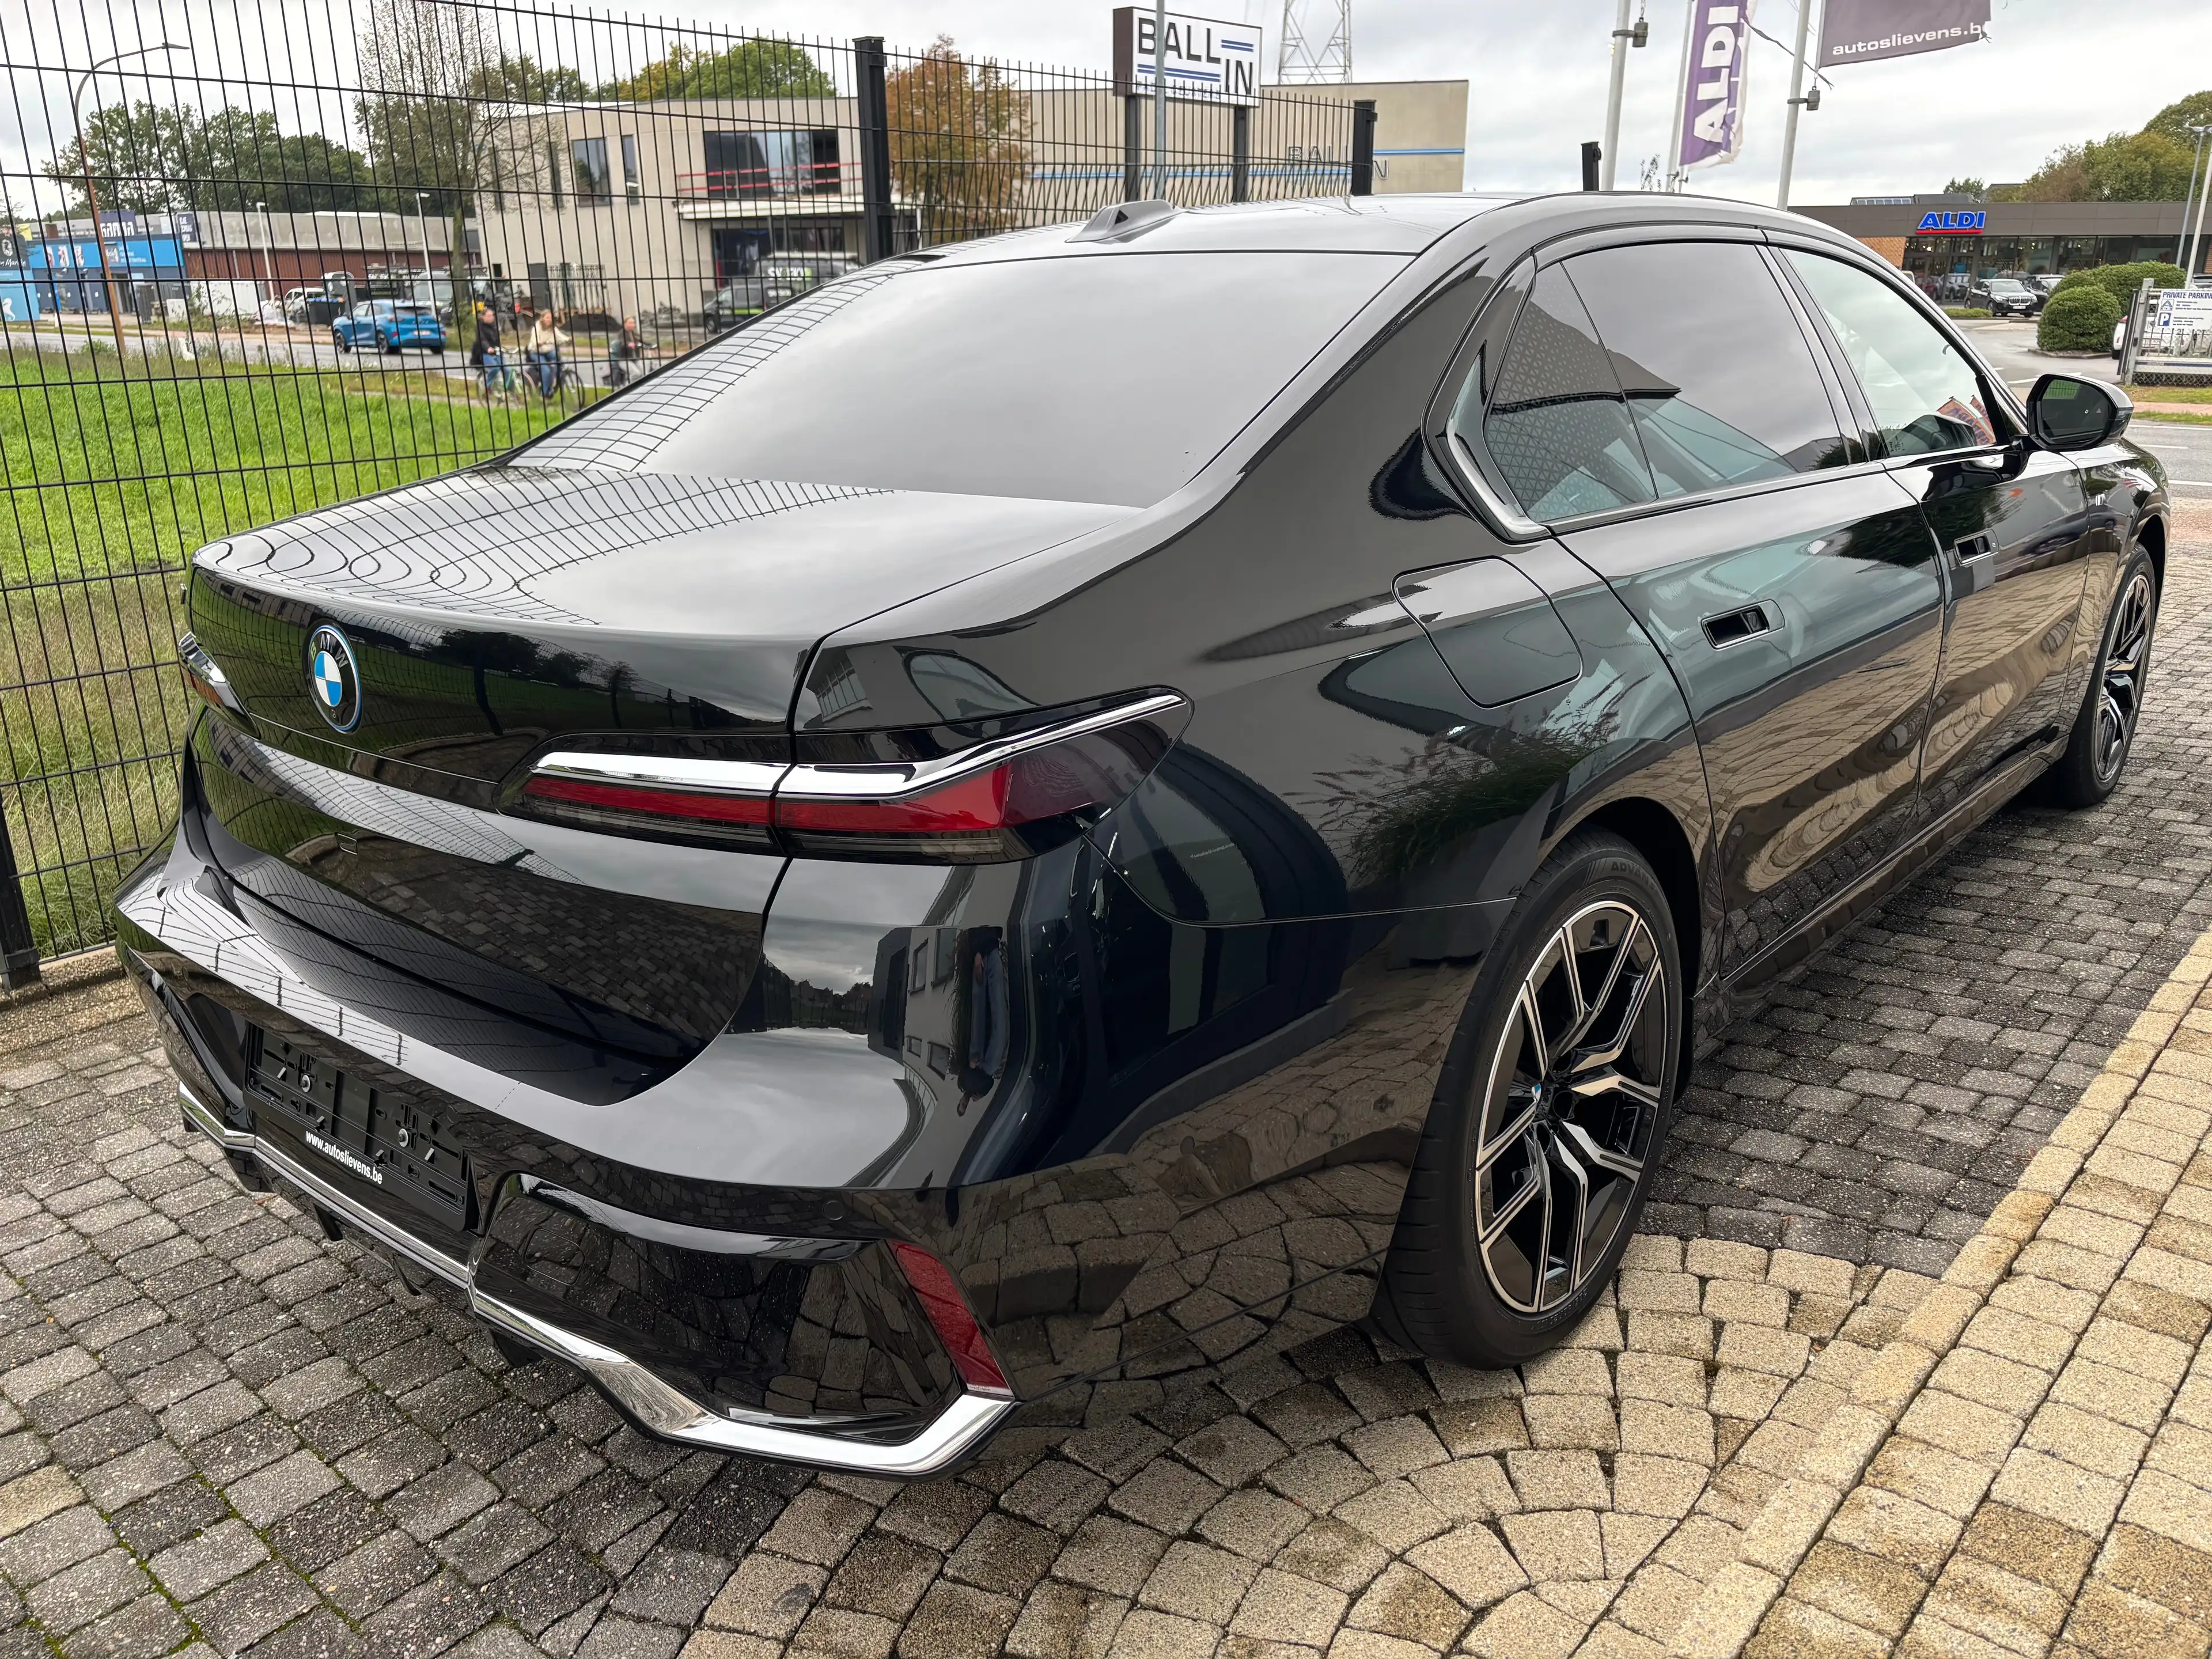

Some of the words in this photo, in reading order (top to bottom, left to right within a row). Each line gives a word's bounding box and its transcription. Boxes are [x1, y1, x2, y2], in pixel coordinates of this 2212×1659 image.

[1138, 17, 1221, 64] BALL
[1225, 59, 1253, 95] IN
[1694, 6, 1738, 142] ALDI
[1917, 211, 1986, 229] ALDI
[310, 633, 349, 668] BMW
[306, 1131, 382, 1184] www.autoslievens.be
